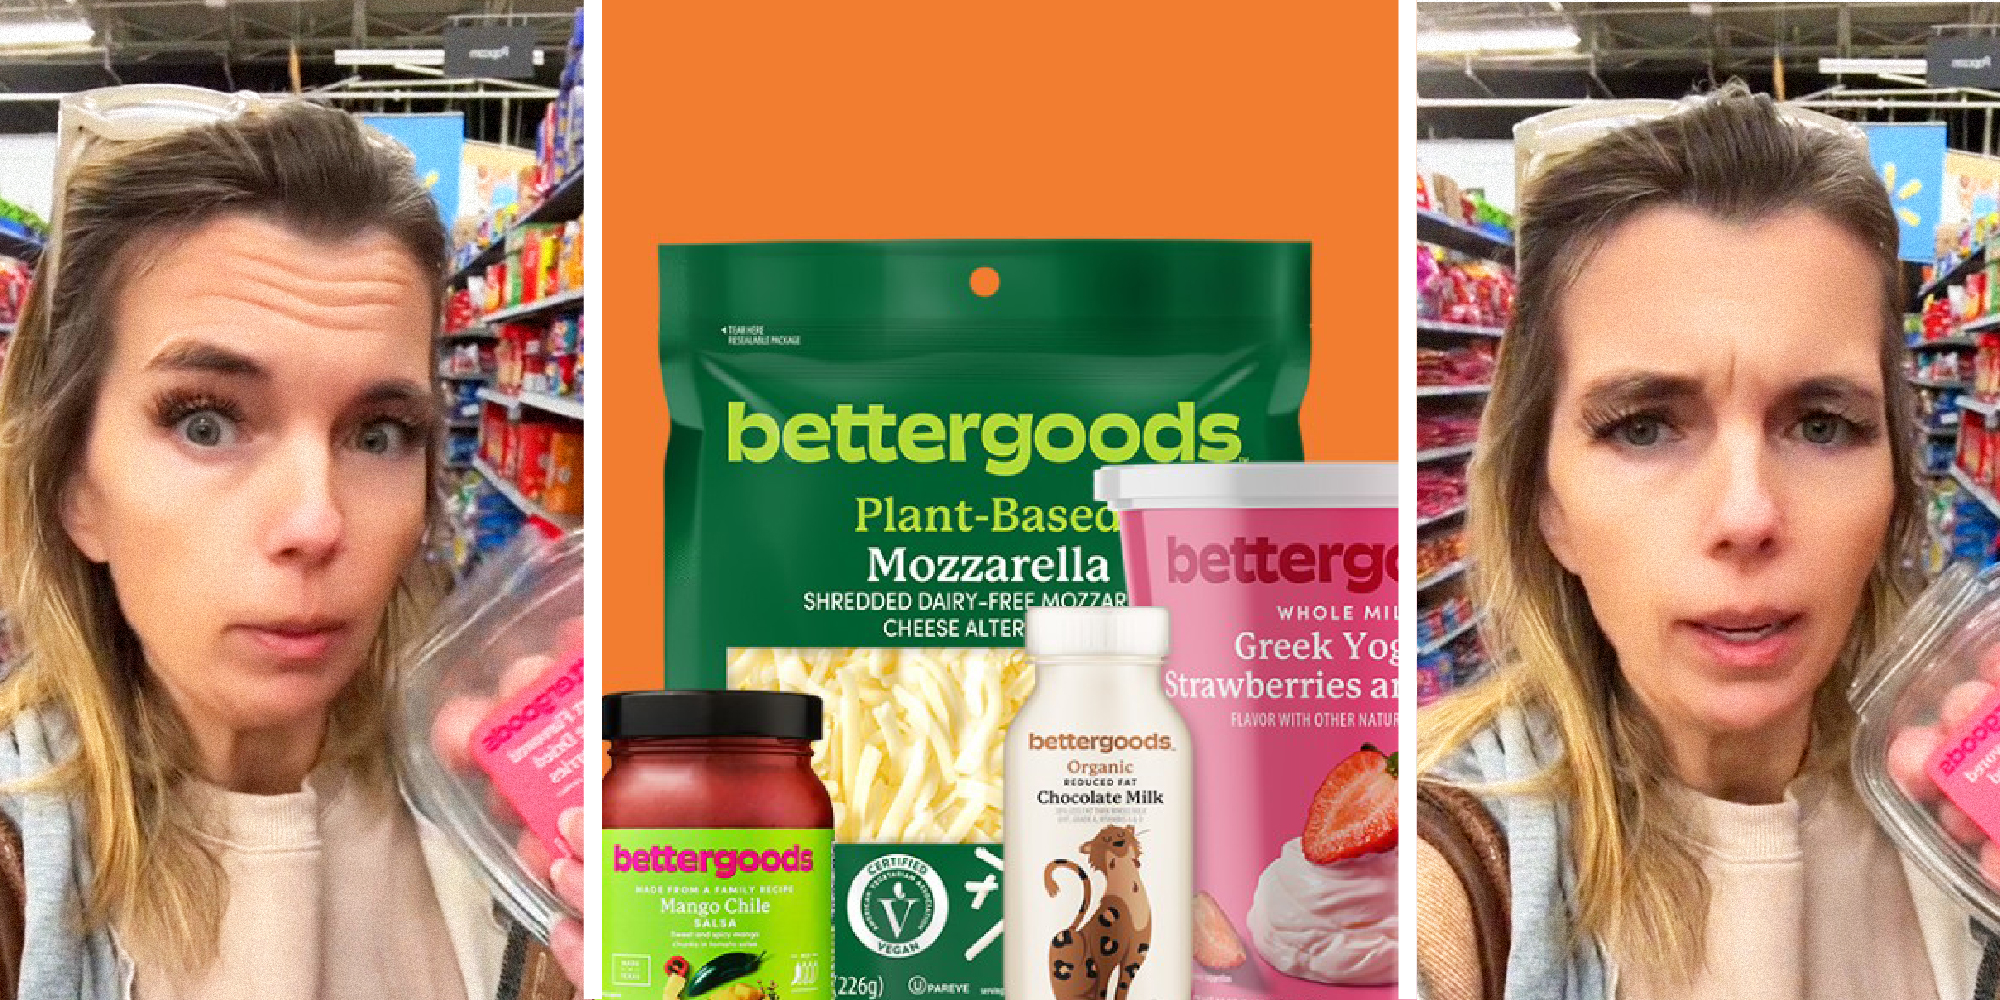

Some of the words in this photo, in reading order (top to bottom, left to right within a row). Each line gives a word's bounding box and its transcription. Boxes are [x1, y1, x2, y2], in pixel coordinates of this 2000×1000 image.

[728, 401, 1242, 475] bettergoods
[867, 546, 1110, 582] Mozzarella
[803, 591, 912, 611] SHREDDED
[919, 591, 1035, 611] DAIRY-FREE
[1276, 605, 1354, 620] WHOLE
[883, 618, 959, 638] CHEESE
[965, 618, 1025, 638] ALTER
[1235, 631, 1333, 660] Greek
[1164, 670, 1361, 699] Strawberries
[1231, 711, 1276, 727] FLAVOR
[1280, 711, 1311, 727] WITH
[1314, 711, 1354, 727] OTHER
[1028, 731, 1172, 754] bettergoods
[1067, 759, 1134, 776] Organic
[1063, 778, 1114, 787] REDUCED
[1118, 778, 1138, 787] FAT
[1037, 790, 1123, 805] Chocolate
[1126, 790, 1164, 805] Milk
[614, 844, 813, 879] bettergoods
[867, 857, 927, 875] CERTIFIED
[635, 885, 663, 894] MADE
[667, 885, 699, 894] FROM
[702, 885, 710, 894] A
[715, 885, 755, 894] FAMILY
[759, 885, 795, 894] RECIPE
[661, 898, 720, 916] Mango
[724, 898, 771, 914] Chile
[694, 918, 737, 928] SALSA
[878, 940, 920, 954] VEGAN
